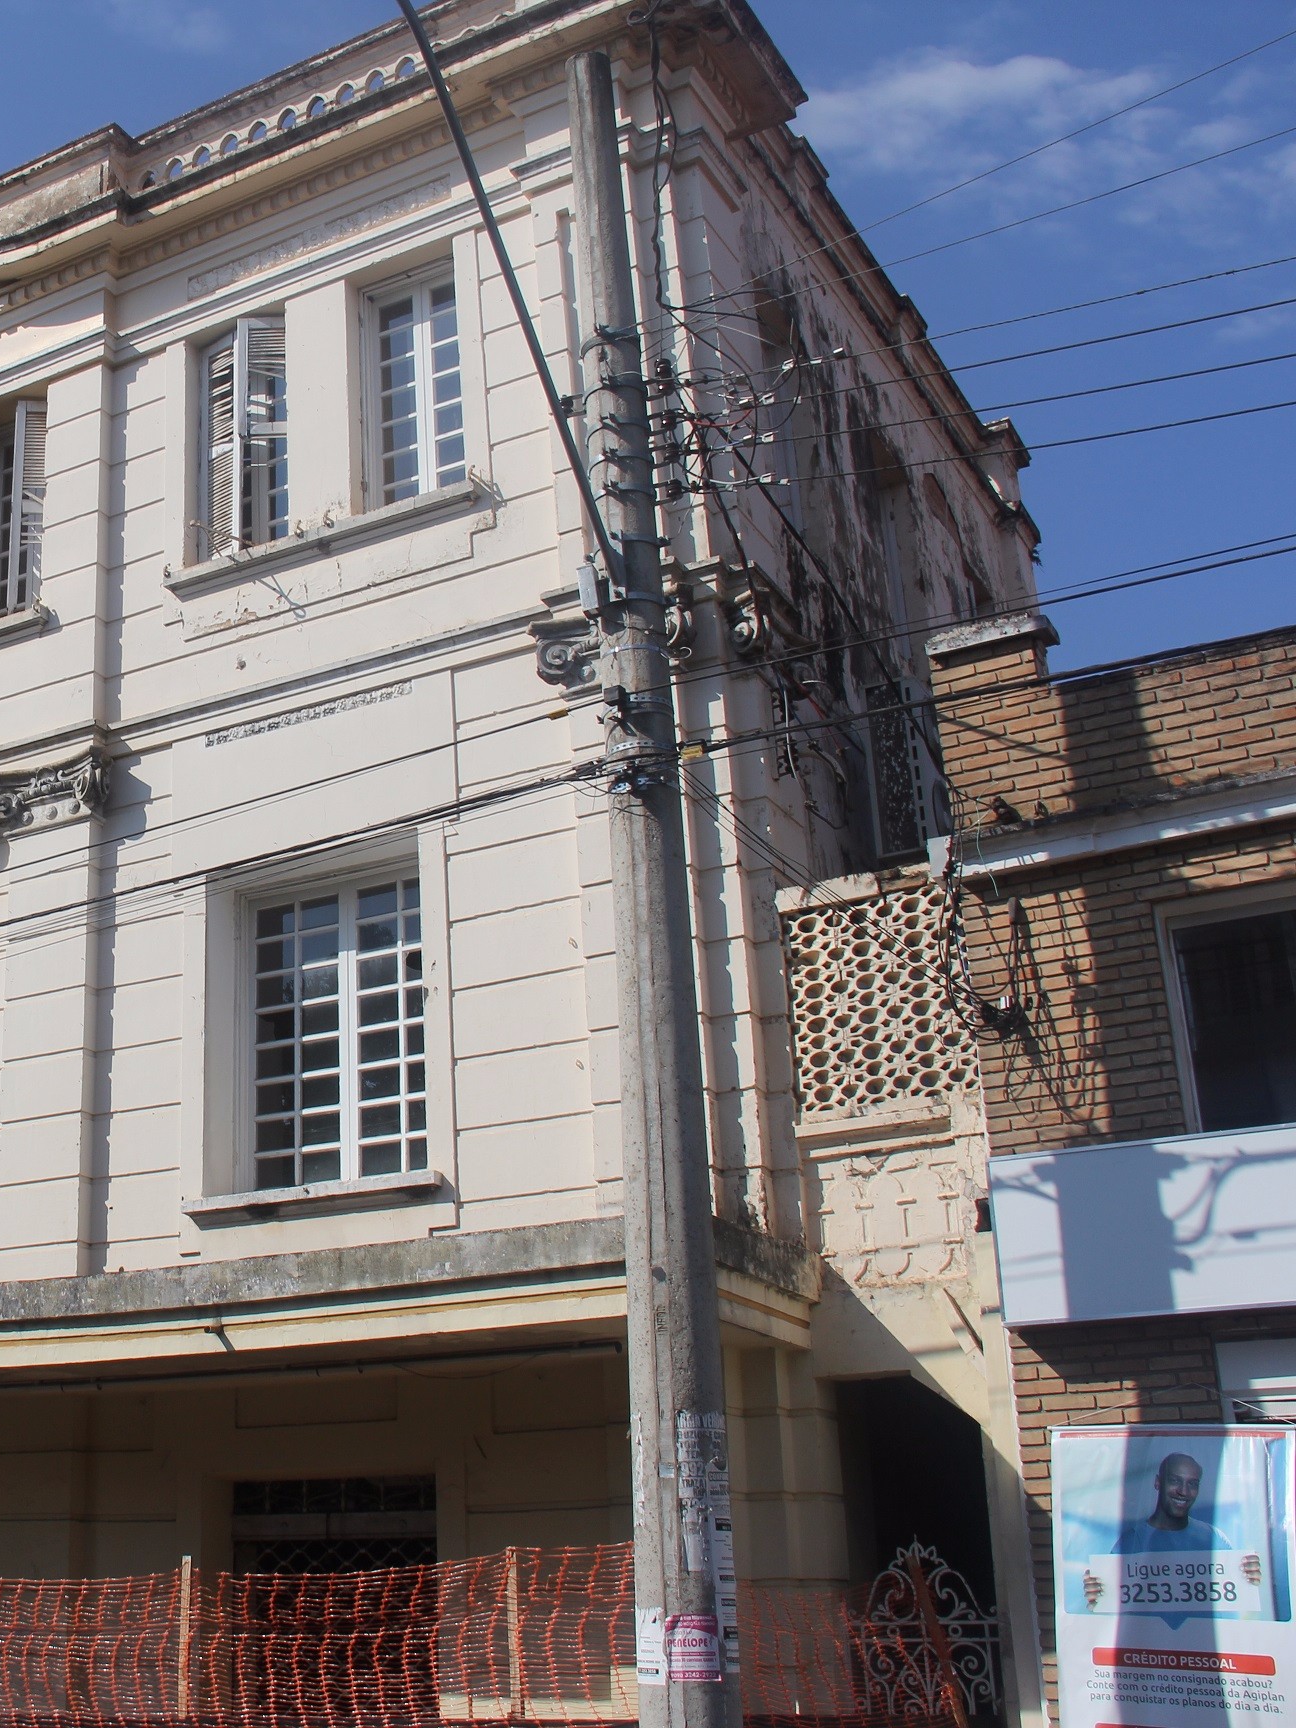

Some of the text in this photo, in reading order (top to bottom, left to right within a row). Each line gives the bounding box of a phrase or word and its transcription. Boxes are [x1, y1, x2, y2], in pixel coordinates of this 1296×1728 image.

[1127, 1562, 1225, 1580] Ligue agora
[1120, 1581, 1238, 1604] 3253.3858
[1123, 1651, 1237, 1670] CRÉDITO PESSOAL
[1094, 1669, 1273, 1689] Sua margem no consignado acabou?
[1086, 1680, 1115, 1690] Conte
[1117, 1683, 1139, 1691] com
[1150, 1683, 1184, 1694] crédito
[1186, 1686, 1226, 1697] pessoal
[1227, 1688, 1240, 1698] da
[1243, 1690, 1285, 1702] Agiplan
[1090, 1692, 1283, 1714] para conquistar os planos do dia a dia.
